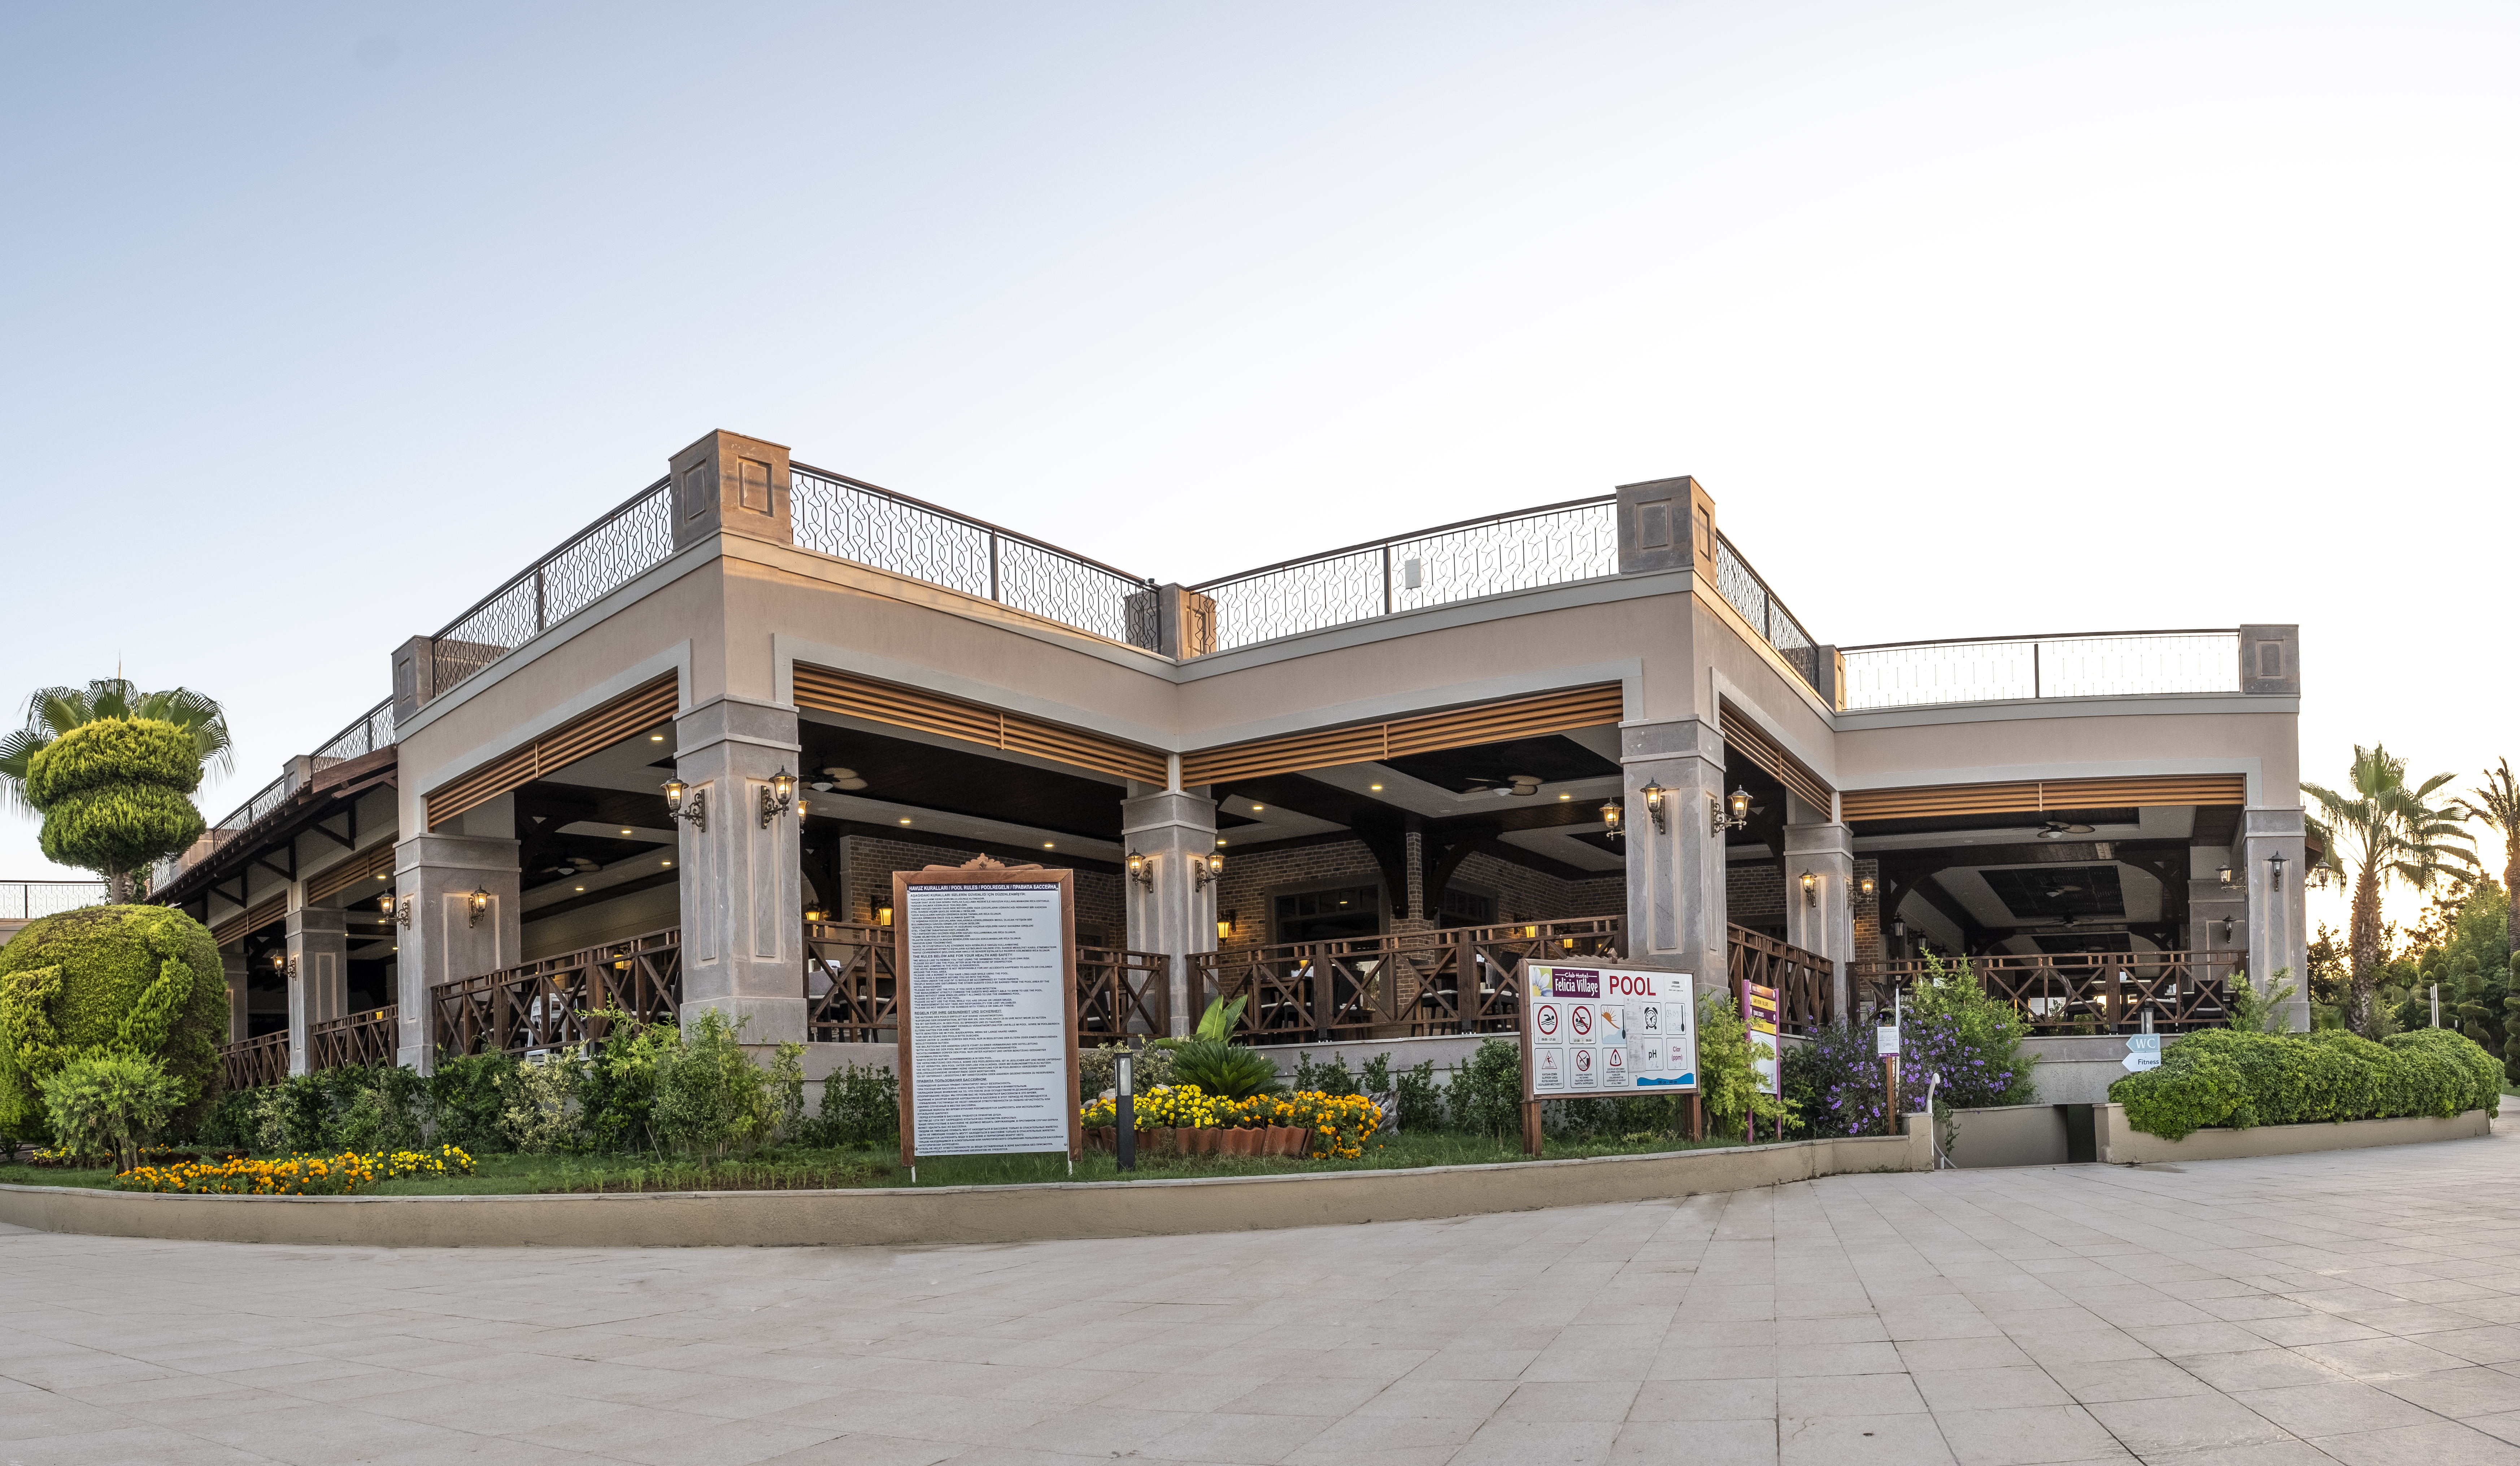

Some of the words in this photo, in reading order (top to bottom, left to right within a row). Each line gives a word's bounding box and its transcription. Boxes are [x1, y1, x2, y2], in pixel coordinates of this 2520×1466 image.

[1555, 978, 1575, 992] Felicia
[1576, 979, 1598, 996] Village
[1609, 976, 1656, 996] POOL
[2135, 1038, 2156, 1049] WC
[1649, 1049, 1657, 1060] pH
